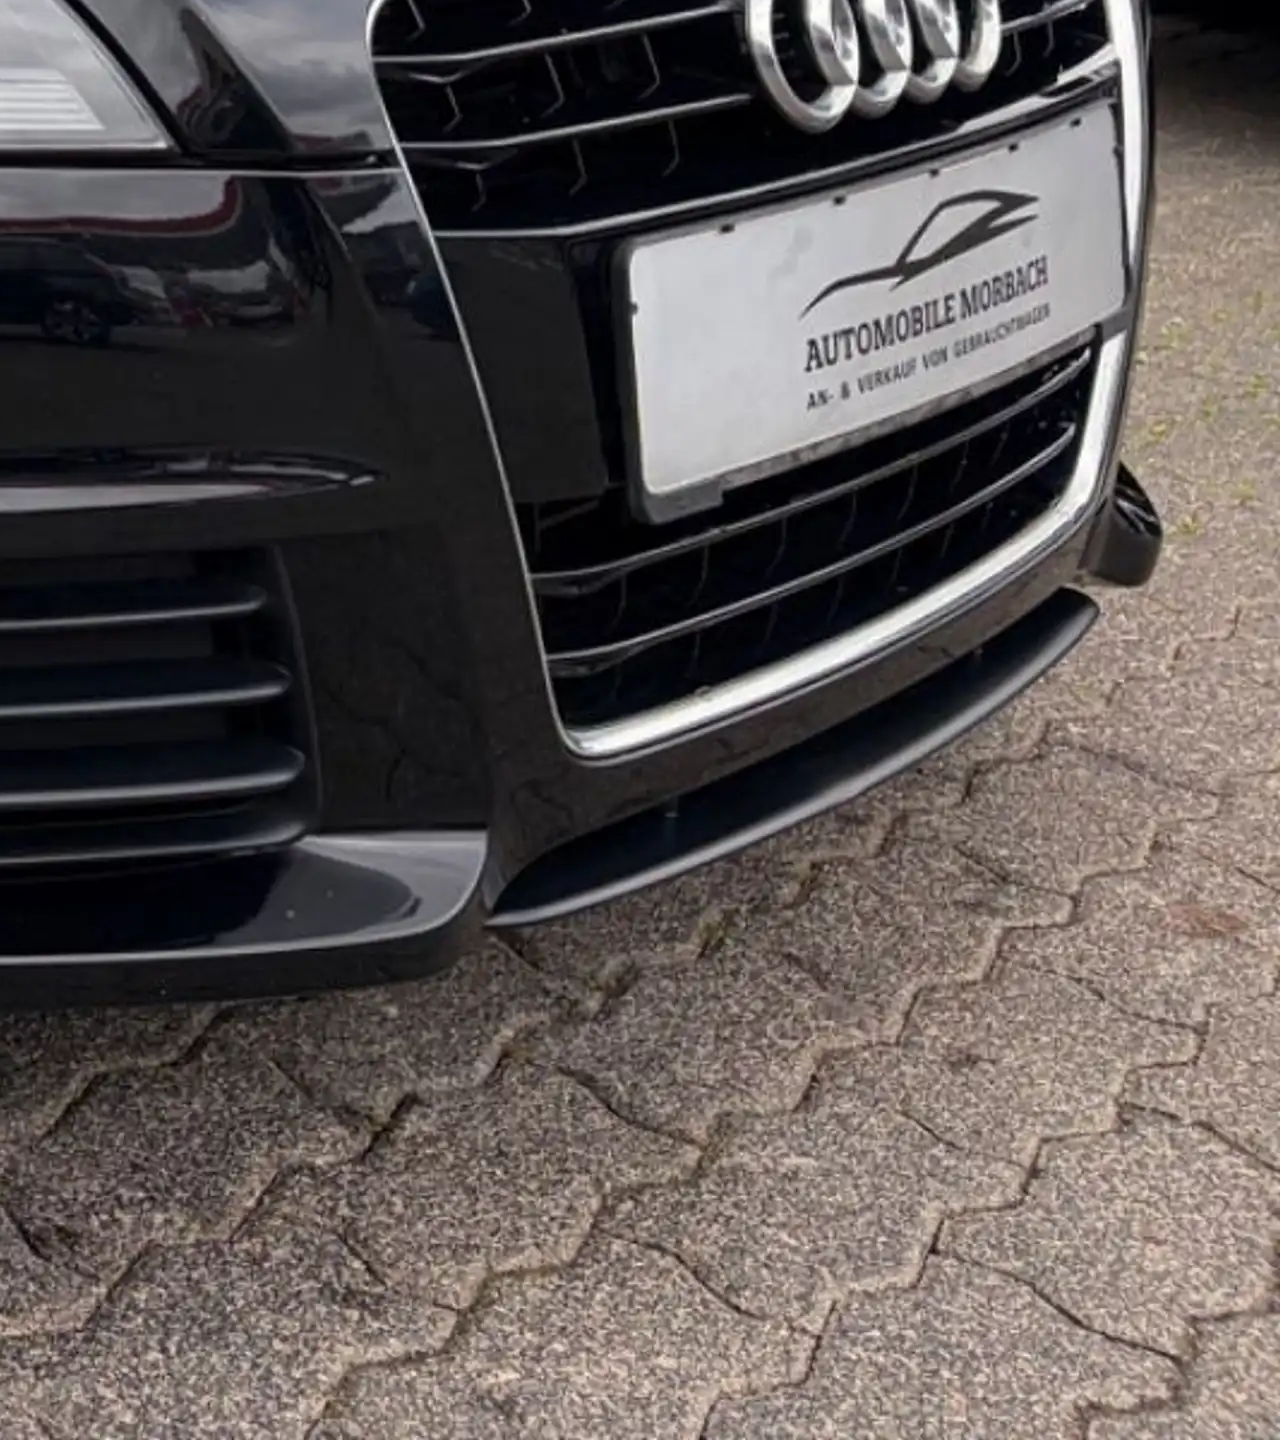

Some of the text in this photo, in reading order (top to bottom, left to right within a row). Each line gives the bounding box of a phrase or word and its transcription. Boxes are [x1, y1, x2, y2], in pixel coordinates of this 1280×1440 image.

[804, 254, 1049, 372] AUTOMOBILE MORBACH
[857, 357, 917, 395] VERKAUF
[922, 345, 948, 371] VON
